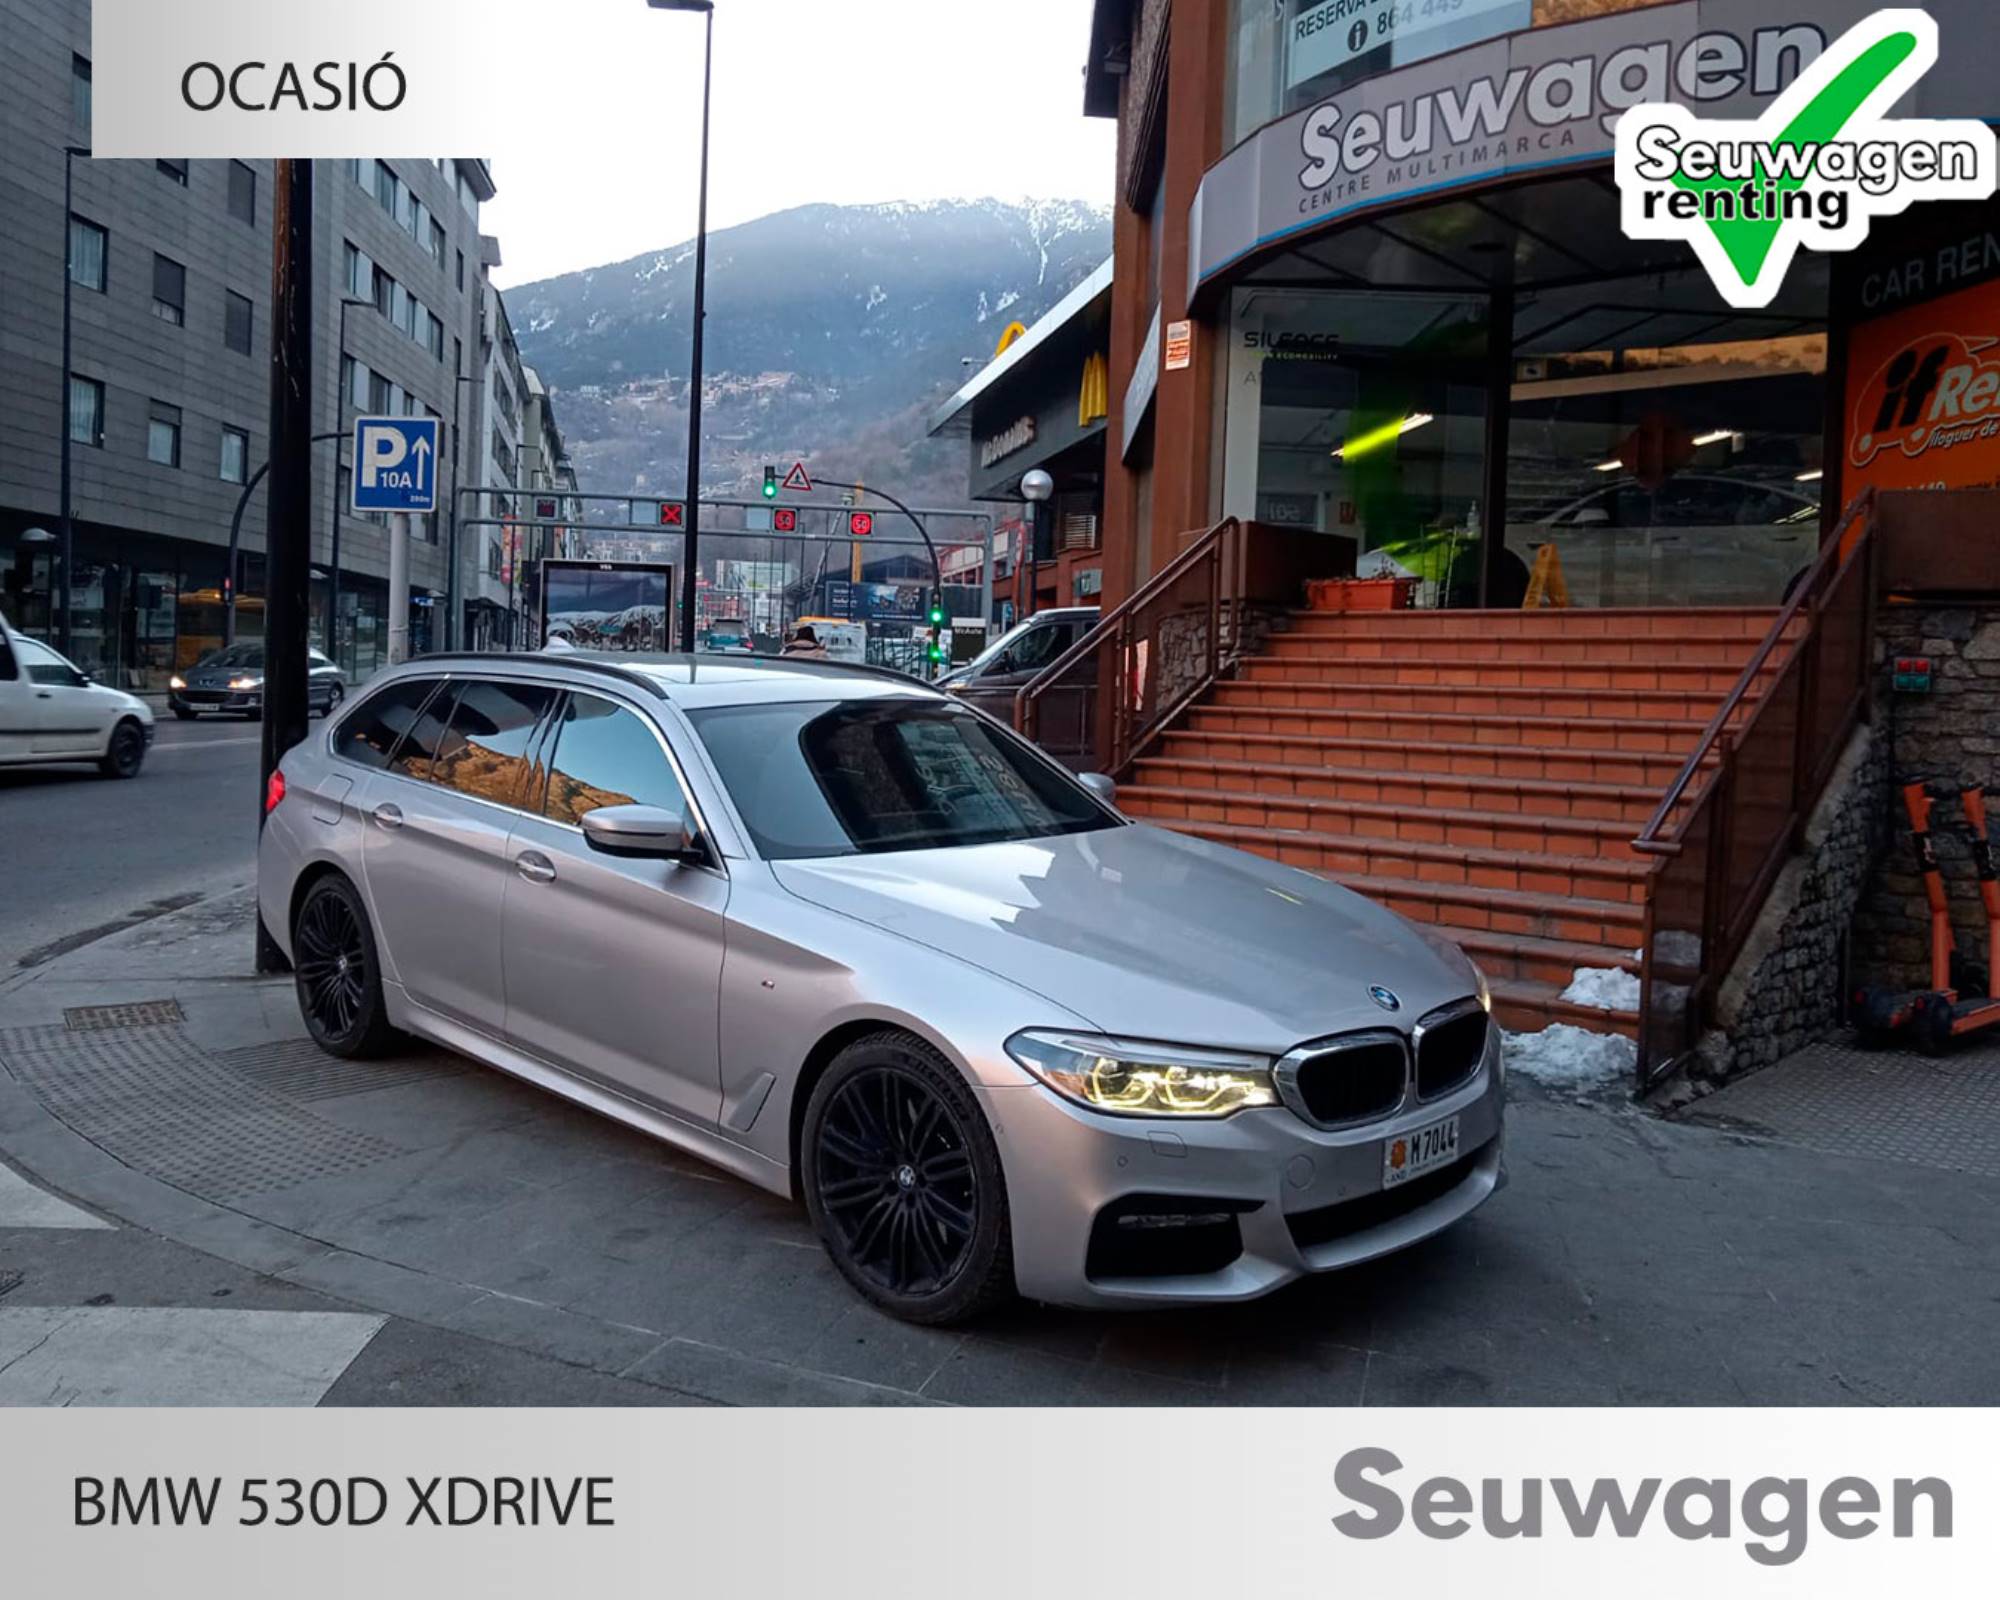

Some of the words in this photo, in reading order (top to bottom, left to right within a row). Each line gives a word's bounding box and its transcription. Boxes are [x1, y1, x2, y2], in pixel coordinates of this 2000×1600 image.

[1299, 23, 1827, 189] Seuwagen
[1299, 175, 1371, 213] CENTRE
[1386, 129, 1575, 184] MULTIMARCA
[1861, 258, 1925, 308] CAR
[1927, 364, 2000, 421] Re
[362, 426, 407, 487] P
[1980, 421, 1999, 437] de
[380, 471, 413, 488] 10A
